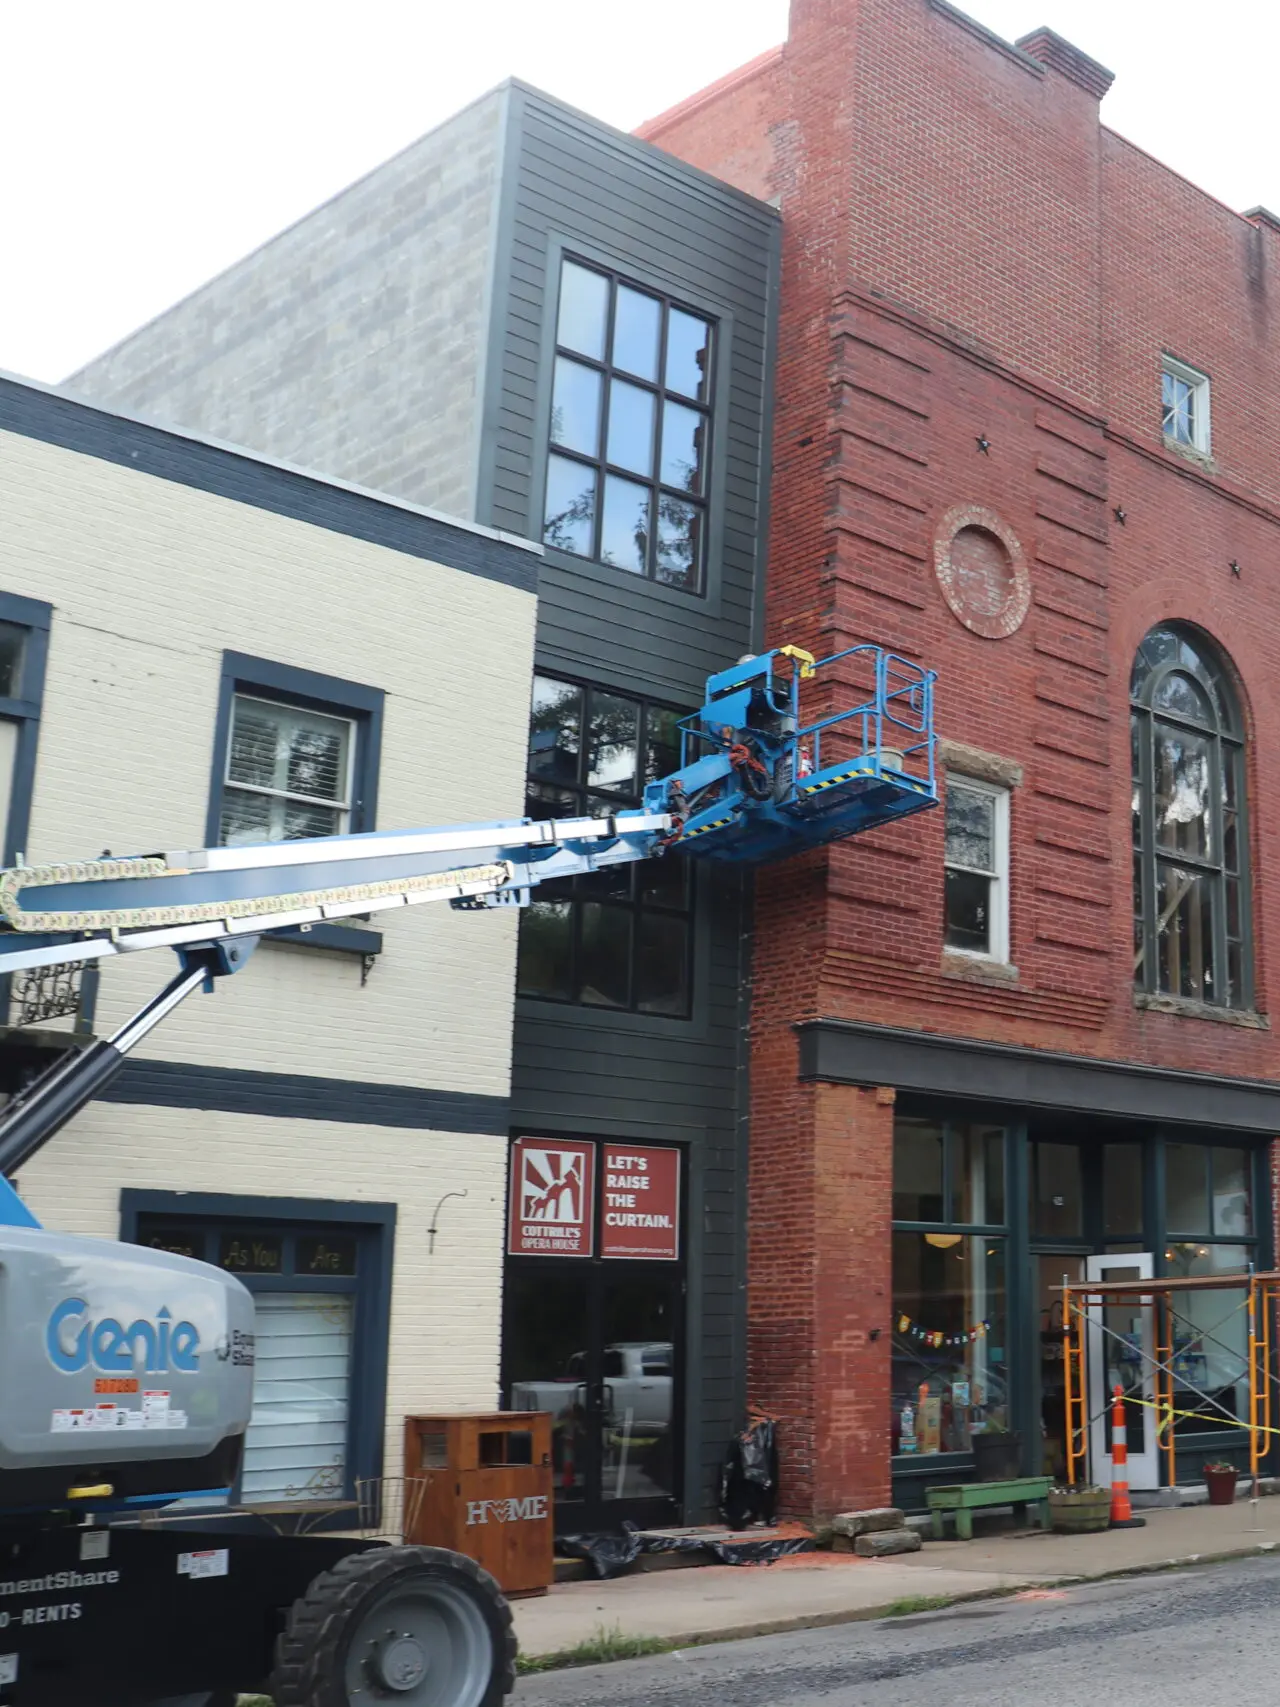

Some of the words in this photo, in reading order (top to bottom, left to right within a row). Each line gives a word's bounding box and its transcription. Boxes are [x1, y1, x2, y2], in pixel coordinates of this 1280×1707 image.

[606, 1155, 648, 1171] LET'S
[606, 1174, 650, 1190] RAISE
[606, 1193, 636, 1208] THE
[605, 1212, 674, 1229] CURTAIN.
[521, 1237, 552, 1250] OPERA
[552, 1238, 581, 1251] HOUSE
[251, 1241, 278, 1267] You
[46, 1296, 200, 1375] Genie
